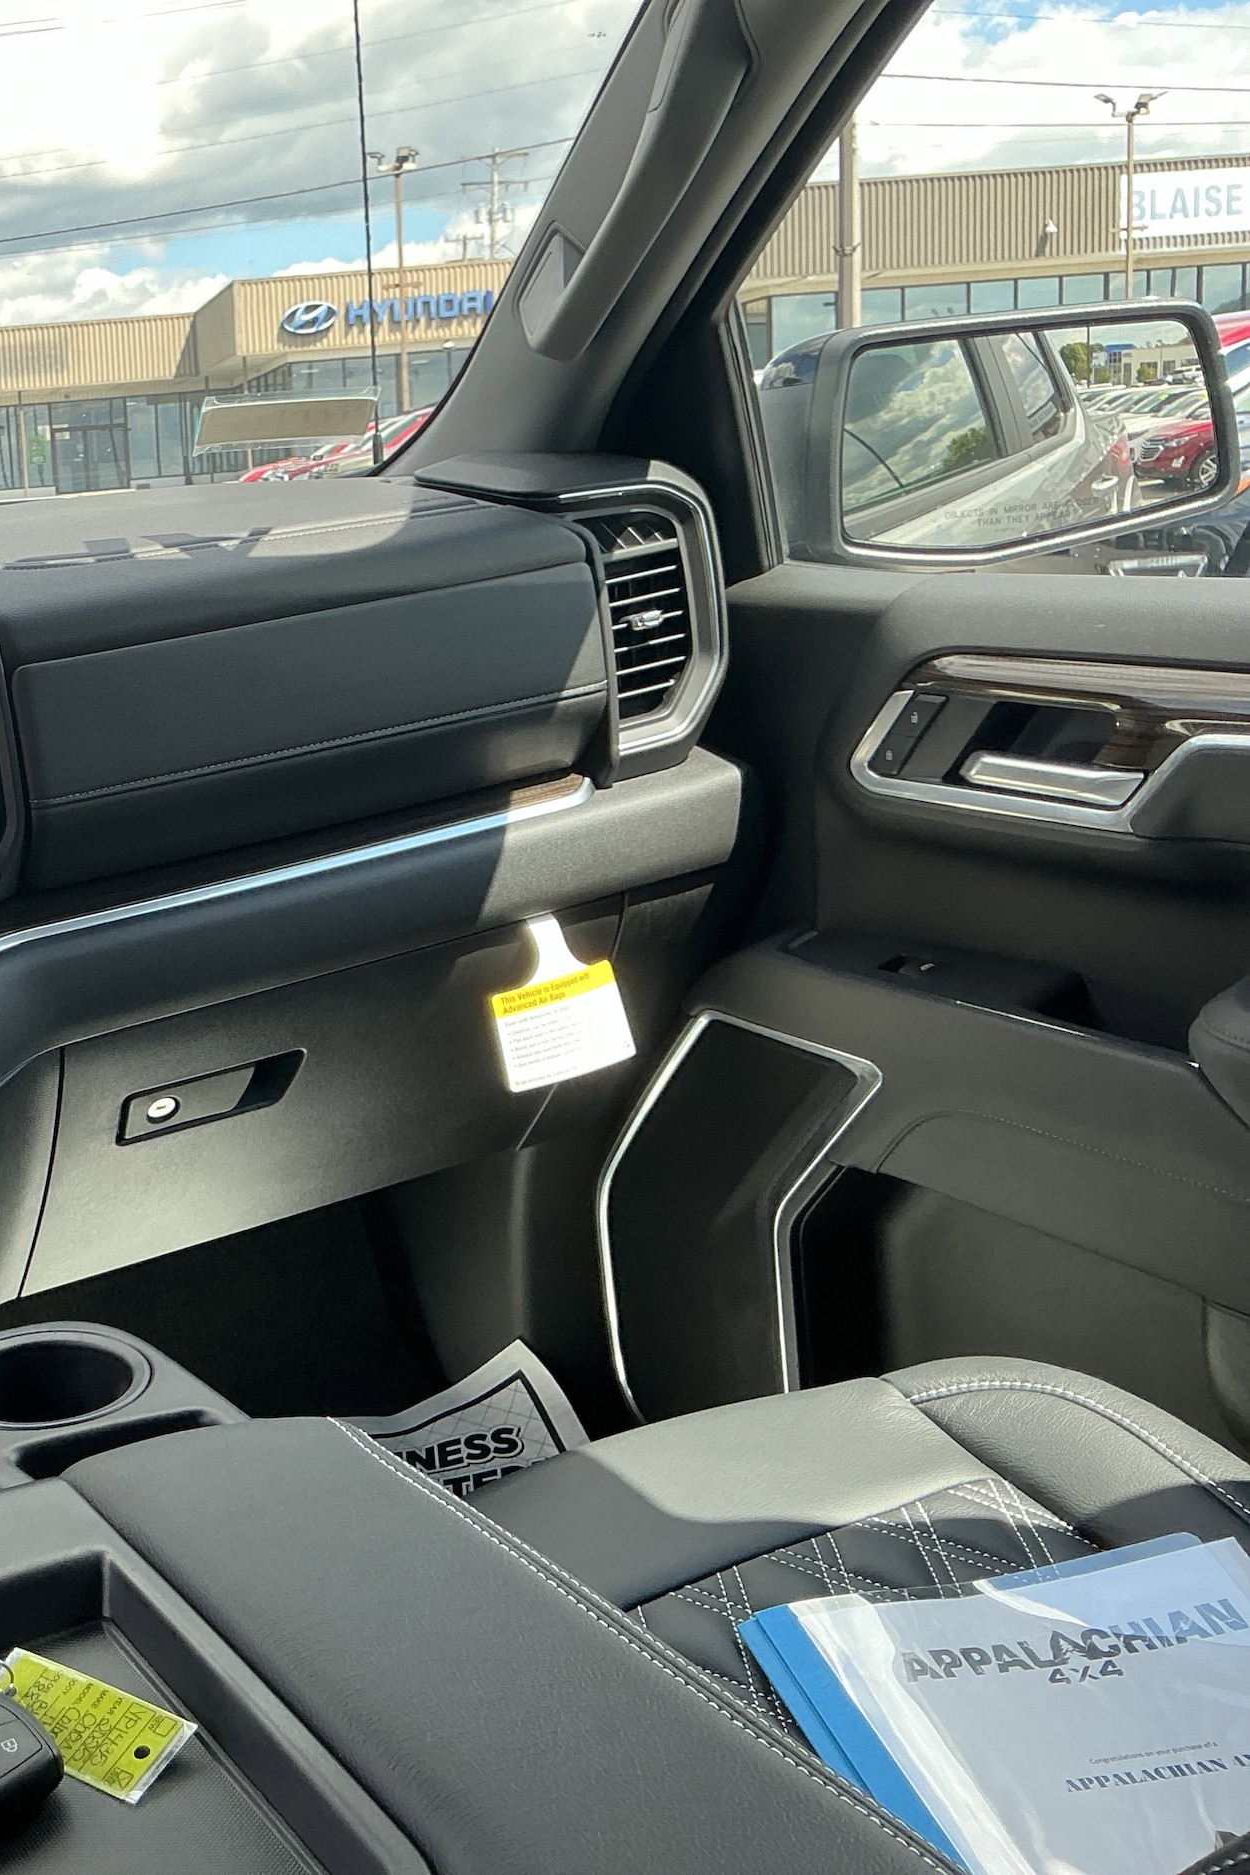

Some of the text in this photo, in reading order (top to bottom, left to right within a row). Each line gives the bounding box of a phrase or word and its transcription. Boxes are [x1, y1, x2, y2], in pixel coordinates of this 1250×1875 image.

[1131, 184, 1243, 222] BLAISE
[348, 290, 493, 325] HYUNDAI
[944, 496, 1100, 520] OBJECTS IN MIRROR ARE CLOSER
[977, 509, 1071, 528] THAN THEY APPEAR
[500, 995, 516, 1005] This
[517, 988, 542, 1000] Vehicle
[543, 985, 550, 994] is
[551, 977, 578, 992] Equipped
[502, 991, 566, 1015] Advanced Air Bags
[901, 1598, 1249, 1684] APPALACHIAN
[1048, 1659, 1124, 1686] 4X4
[72, 1682, 94, 1706] MODEL
[90, 1689, 109, 1710] MAKE
[107, 1696, 124, 1716] YEAR
[148, 1714, 162, 1732] NEW
[1089, 1752, 1145, 1766] Congratulations
[1144, 1750, 1155, 1758] on
[1155, 1748, 1171, 1757] your
[1172, 1742, 1203, 1755] purchase
[1203, 1740, 1212, 1748] of
[1065, 1757, 1229, 1793] APPALACHIAN
